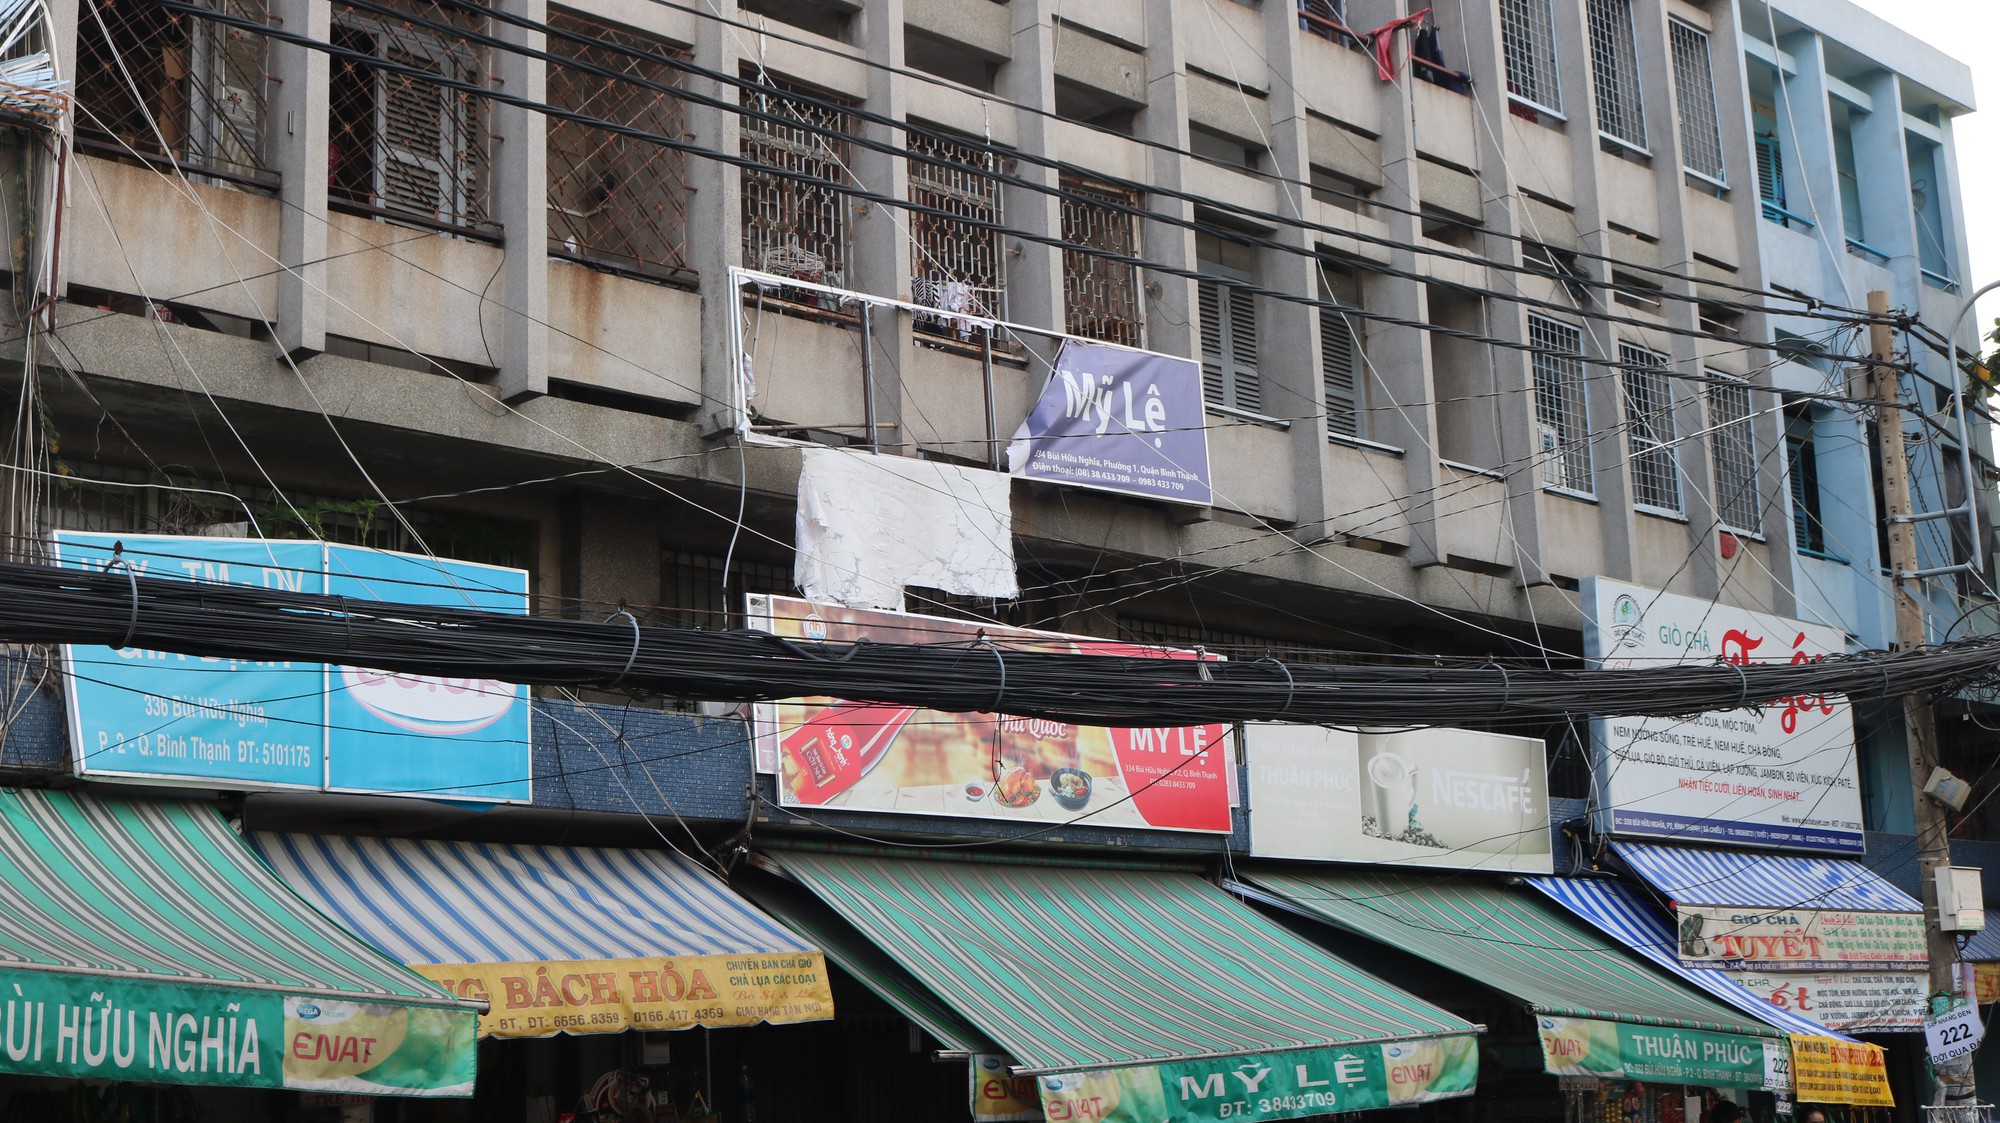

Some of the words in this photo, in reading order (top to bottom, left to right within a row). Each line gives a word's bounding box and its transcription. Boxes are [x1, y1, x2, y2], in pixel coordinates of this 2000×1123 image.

[1062, 370, 1113, 438] Mỹ
[1123, 381, 1165, 448] Lệ
[1032, 462, 1051, 472] Điện
[1052, 464, 1074, 476] thoại:
[1075, 467, 1090, 477] (08)
[1091, 470, 1100, 478] 38
[1102, 472, 1115, 480] 433
[1117, 474, 1130, 483] 709
[1138, 477, 1156, 486] 0983
[1157, 480, 1170, 488] 433
[1171, 482, 1184, 490] 709
[1047, 450, 1060, 460] Bùi
[1061, 453, 1077, 462] Hữu
[1078, 455, 1102, 467] Nghĩa,
[1103, 459, 1131, 473] Phường
[1133, 465, 1140, 473] 1,
[1141, 465, 1159, 477] Quận
[1160, 467, 1177, 479] Bình
[1177, 471, 1199, 482] Thạnh
[1658, 622, 1682, 647] GIÒ
[1685, 630, 1711, 653] CHẢ
[144, 694, 169, 716] 336
[172, 695, 195, 718] Bùi
[1704, 716, 1721, 730] CUA,
[1722, 717, 1738, 732] MỘC
[1739, 720, 1757, 735] TÔM,
[116, 732, 126, 754] 2
[138, 732, 153, 757] Q.
[157, 734, 186, 759] Bình
[191, 736, 230, 765] Thạnh
[238, 740, 258, 764] ĐT:
[263, 742, 311, 767] 5101175
[1613, 725, 1630, 738] NEM
[1698, 735, 1714, 751] HUẾ,
[1714, 740, 1730, 751] NEM
[1731, 741, 1747, 755] HUẾ,
[1125, 764, 1135, 773] 334
[1136, 765, 1144, 773] Bùi
[1146, 765, 1157, 774] Hữu
[1759, 768, 1786, 782] JAMBON,
[1159, 779, 1172, 787] 0283
[1432, 768, 1531, 814] NESCAFÉ
[1679, 777, 1697, 791] NHẬN
[1698, 779, 1713, 793] TIỆC
[1732, 783, 1746, 795] LIÊN
[1768, 789, 1783, 800] SINH
[1731, 912, 1759, 925] GIÒ
[1766, 912, 1800, 926] CHẢ
[1713, 929, 1822, 959] TUYẾT
[726, 959, 759, 971] CHUYÊN
[780, 958, 796, 969] CHẢ
[799, 957, 812, 968] GIÒ
[500, 966, 621, 1009] BÁCH
[629, 961, 718, 1003] HÓA
[729, 974, 748, 986] CHẢ
[751, 975, 771, 988] LỤA
[772, 972, 790, 985] CÁC
[791, 973, 816, 987] LOẠI
[500, 1018, 522, 1031] BT,
[528, 1017, 550, 1028] ĐT:
[554, 1012, 619, 1028] 6656.8359
[634, 1007, 724, 1023] 0166.417.4369
[735, 1006, 756, 1017] GIAO
[757, 1004, 780, 1017] HÀNG
[0, 984, 44, 1062] ÙI
[56, 991, 135, 1068] HỮU
[148, 1002, 260, 1075] NGHĨA
[1940, 1023, 1973, 1046] 222
[293, 1032, 377, 1064] ENAT
[1631, 1033, 1697, 1063] THUẬN
[1703, 1038, 1752, 1064] PHÚC
[1949, 1045, 1968, 1057] QUA
[1179, 1063, 1273, 1100] MỸ
[1295, 1053, 1367, 1088] LỆ
[1391, 1064, 1432, 1085] ENAT
[1773, 1057, 1789, 1075] 222
[1048, 1097, 1103, 1121] ENAT
[1219, 1100, 1252, 1117] ĐT:
[1258, 1091, 1335, 1113] 38433709
[1777, 1101, 1791, 1113] 222
